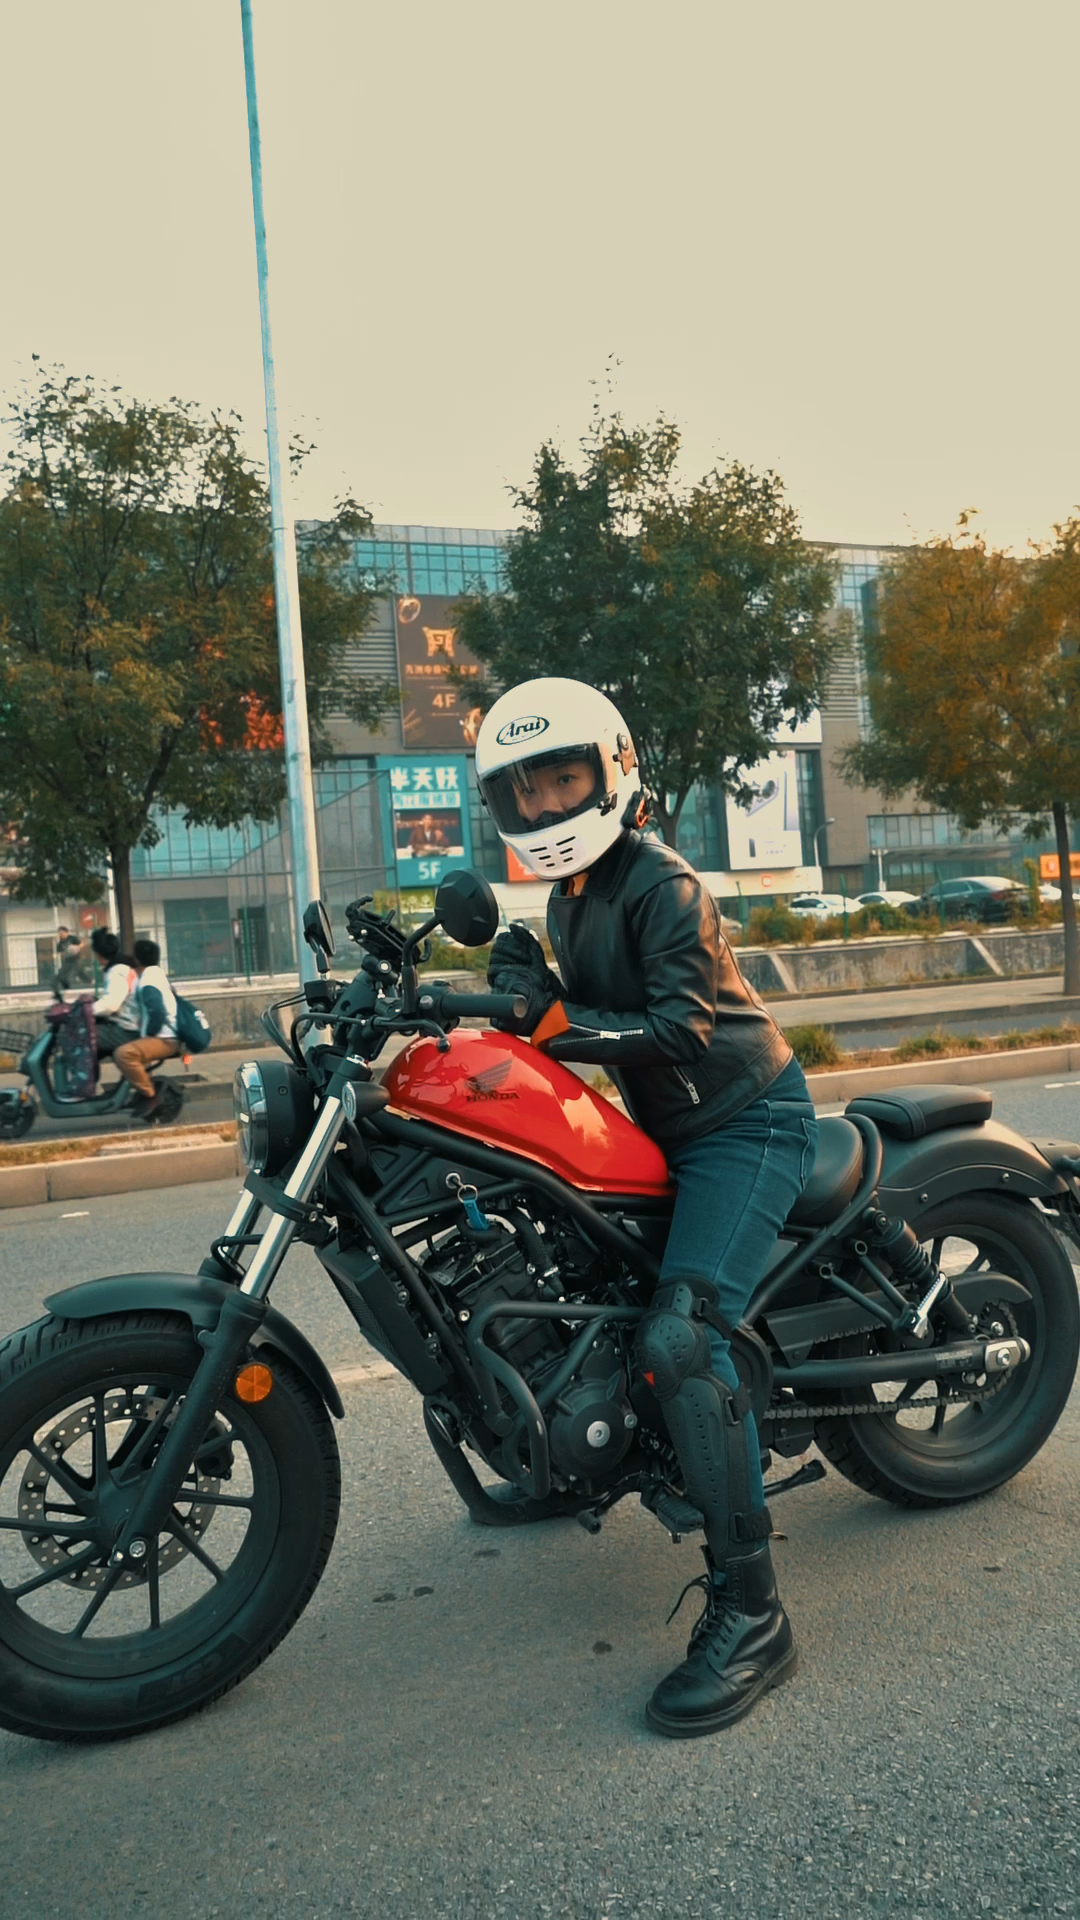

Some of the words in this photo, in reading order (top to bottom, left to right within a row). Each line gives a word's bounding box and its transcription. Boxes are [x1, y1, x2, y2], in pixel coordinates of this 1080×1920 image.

[432, 693, 457, 709] 4F
[499, 716, 542, 743] Arai
[418, 860, 442, 880] 5F
[466, 1092, 519, 1102] HONDA
